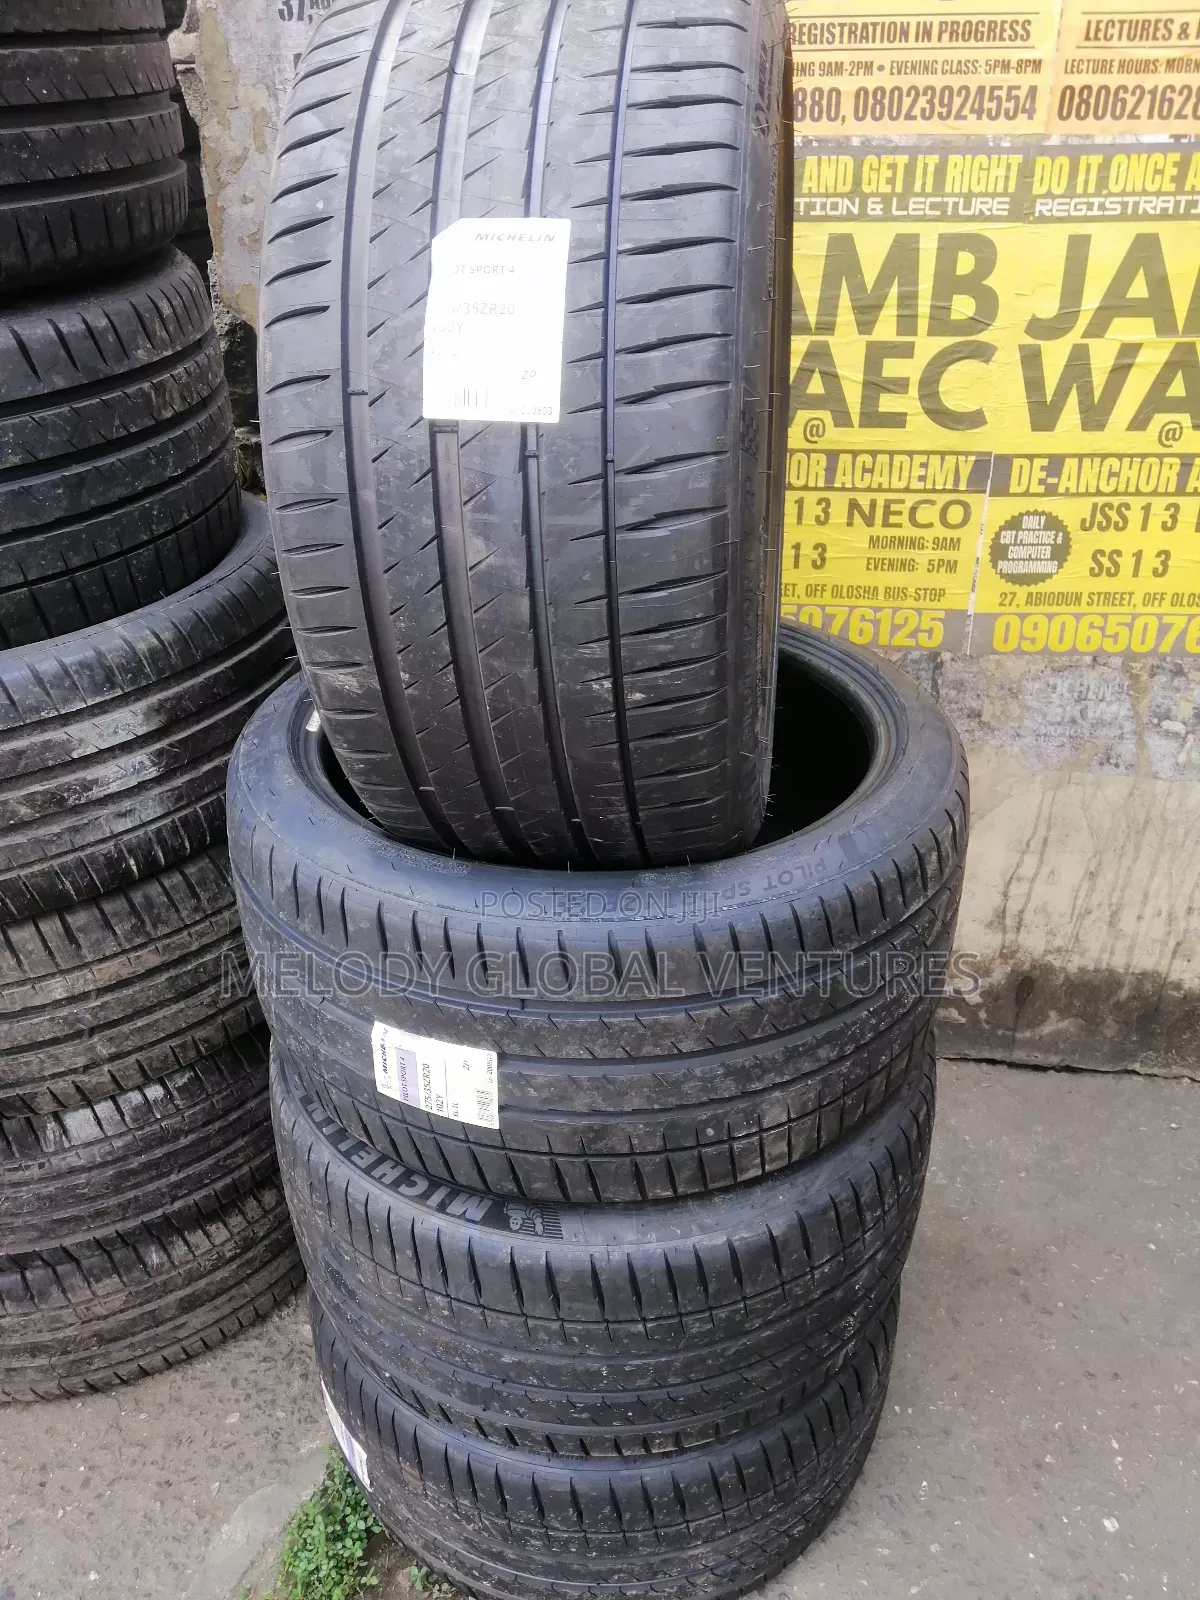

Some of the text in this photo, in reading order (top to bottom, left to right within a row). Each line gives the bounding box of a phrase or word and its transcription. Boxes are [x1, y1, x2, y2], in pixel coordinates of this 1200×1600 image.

[789, 18, 1032, 45] REGISTRATION IN PROGRESS
[1084, 18, 1174, 42] LECTURES
[1177, 22, 1190, 41] &
[792, 58, 1042, 77] ING 9AM-2PM EVENING CLASS: 5PM-8PM
[1064, 59, 1115, 75] LECTURE
[1116, 59, 1163, 75] HOURS:
[853, 84, 1037, 121] 08023924554
[802, 155, 853, 193] AND
[861, 155, 909, 193] GET
[914, 155, 939, 192] IT
[944, 154, 1023, 193] RIGHT
[1032, 156, 1068, 195] DO
[867, 198, 883, 215] &
[891, 196, 1010, 216] LECTURE
[474, 233, 556, 243] MICHELIN
[789, 339, 998, 431] AEC
[803, 416, 826, 444] @
[1158, 420, 1183, 448] @
[834, 454, 976, 491] ACADEMY
[1009, 456, 1181, 494] DE-ANCHOR
[814, 496, 831, 526] 3
[846, 498, 972, 529] NECO
[1021, 515, 1046, 529] DAILY
[1080, 502, 1131, 532] JSS
[1140, 502, 1152, 532] 1
[1161, 502, 1180, 532] 3
[868, 535, 961, 552] MORNING: 9AM
[1000, 530, 1063, 544] CBT PRACTICE &
[811, 542, 827, 570] 3
[866, 557, 958, 574] EVENING: 5PM
[1007, 545, 1052, 559] COMPUTER
[1089, 549, 1171, 578] SS 1 3
[997, 560, 1059, 574] PROGRAMMING
[805, 584, 827, 599] OFF
[831, 584, 880, 600] OLOSHA
[883, 586, 946, 603] BUS-STOP
[999, 592, 1020, 609] 27,
[1024, 592, 1083, 607] ABIODUN
[1086, 592, 1137, 609] STREET,
[1141, 592, 1168, 607] OFF
[305, 1101, 494, 1222] MICHELIN
